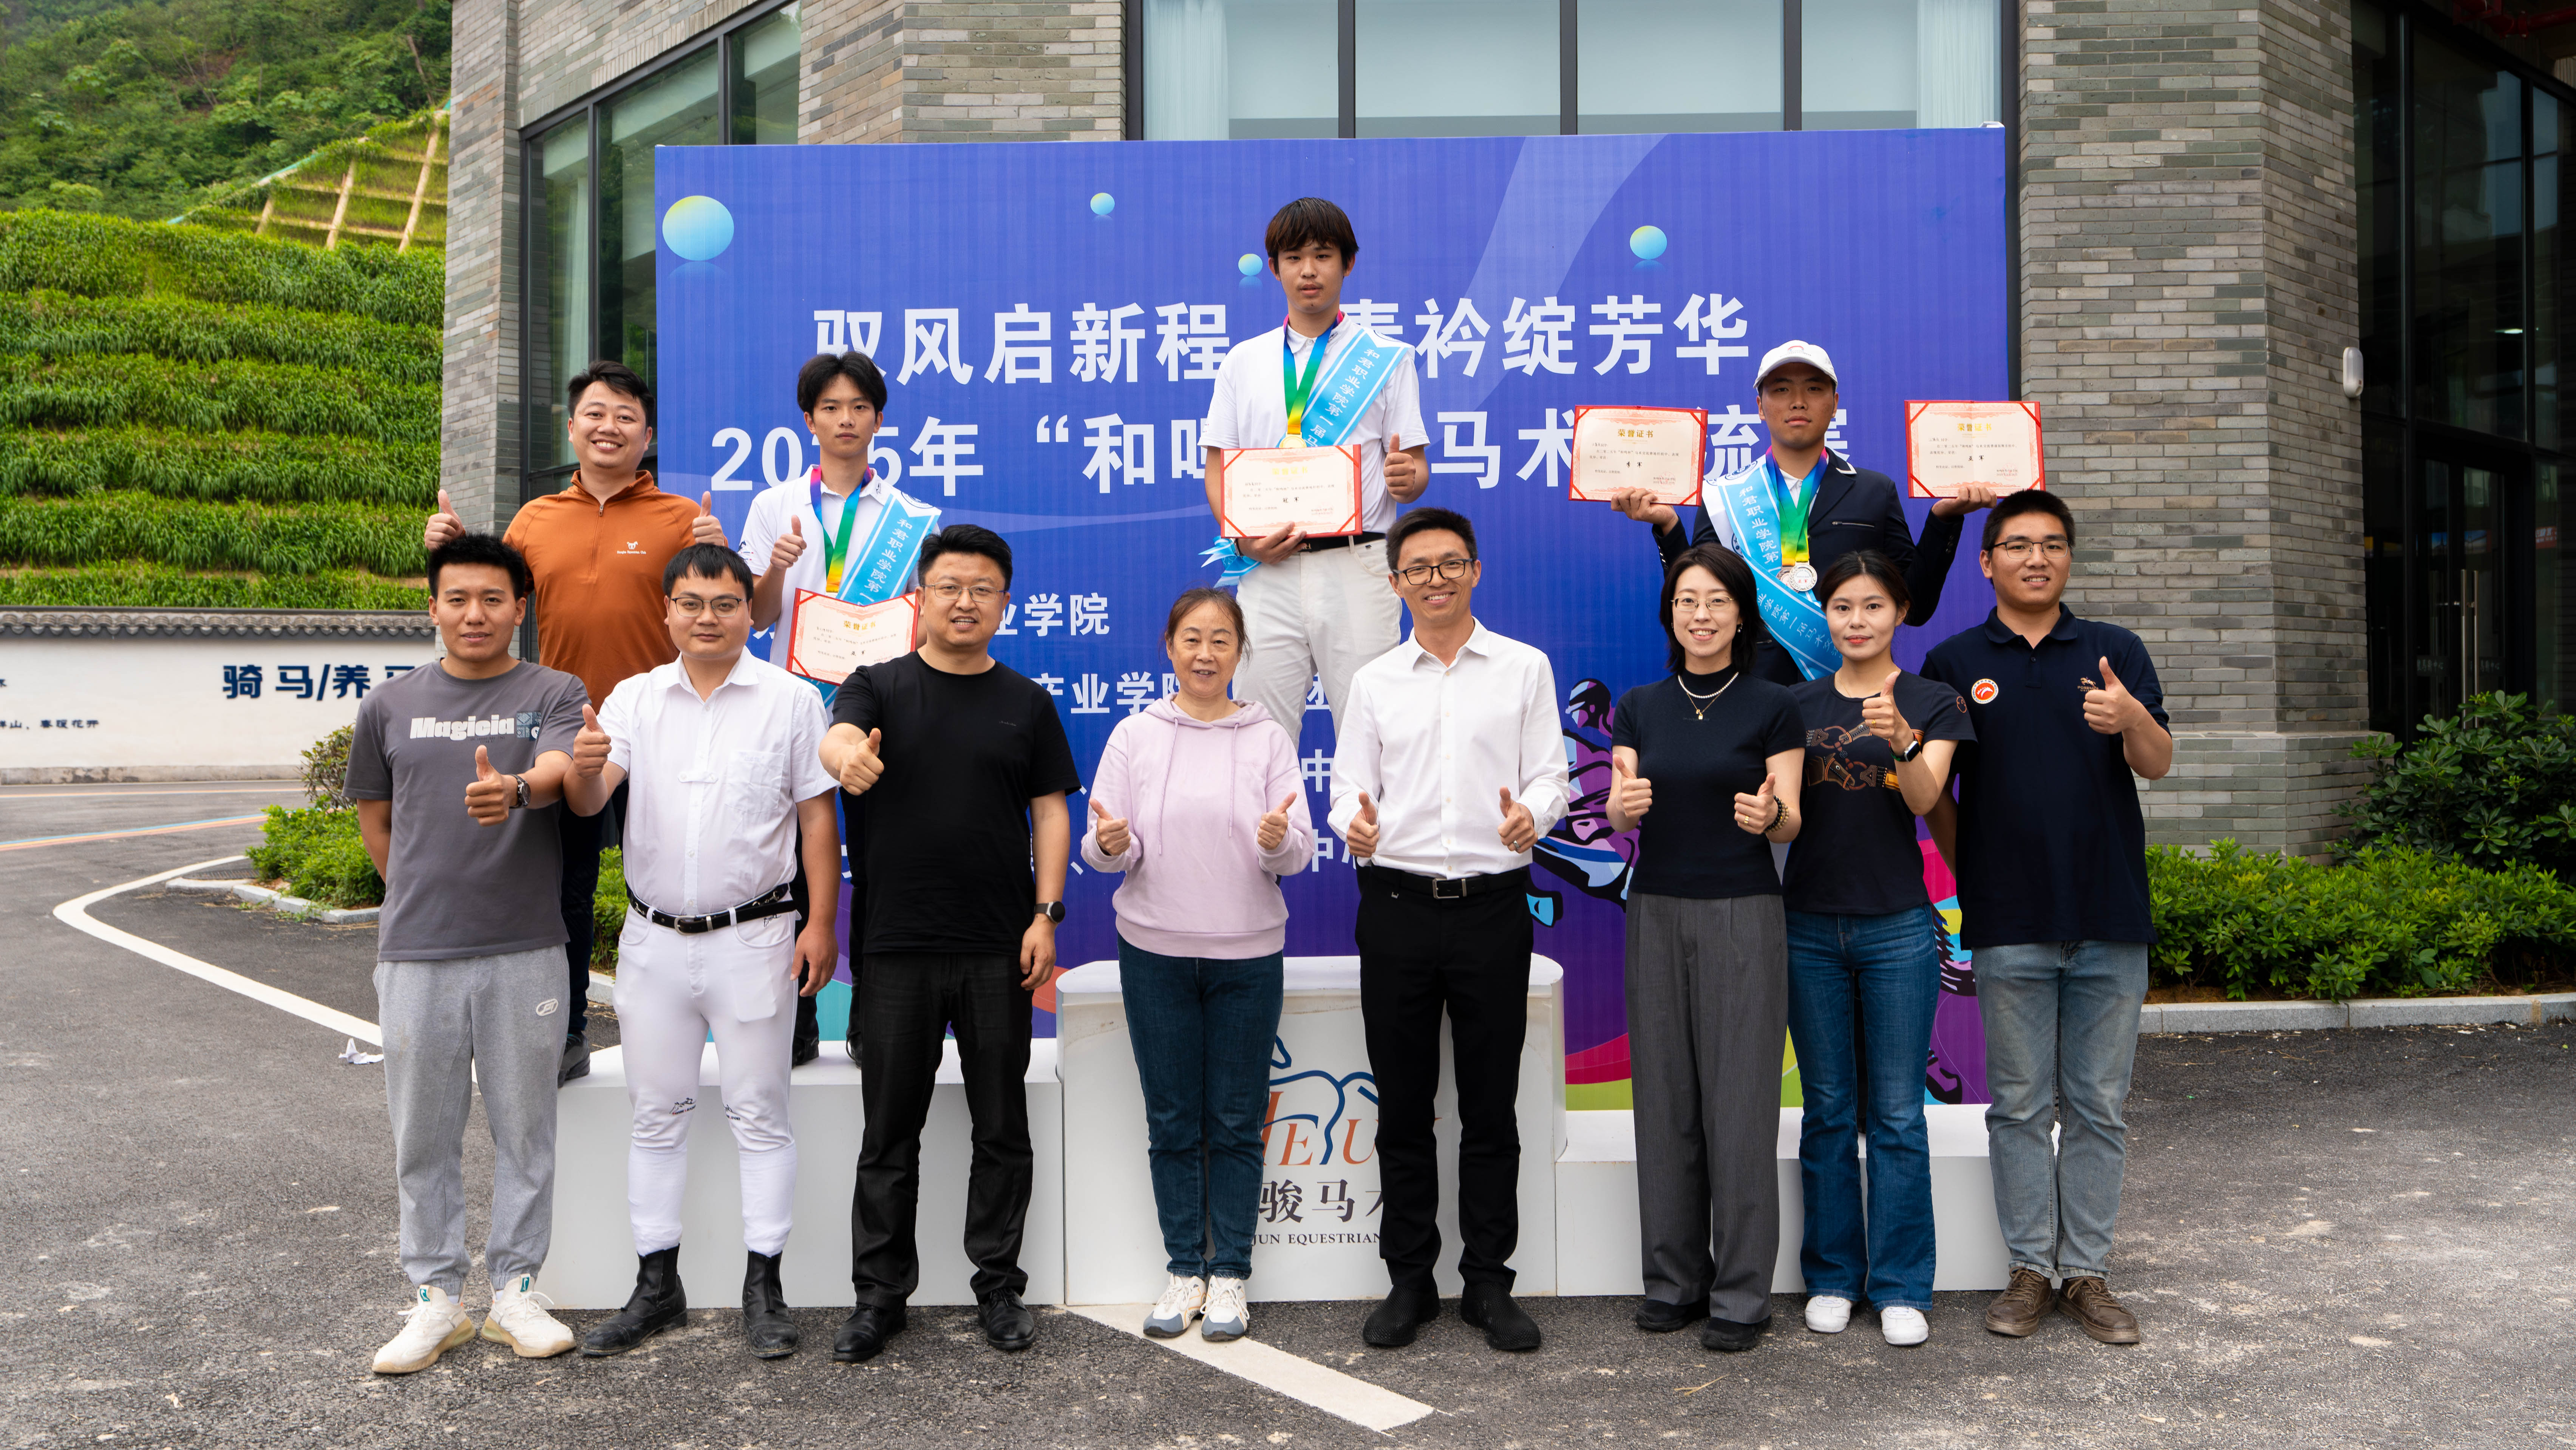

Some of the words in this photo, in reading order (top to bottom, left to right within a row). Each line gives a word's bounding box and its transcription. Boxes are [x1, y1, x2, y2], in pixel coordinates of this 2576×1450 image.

[814, 303, 1230, 385] 驭风启新程
[1618, 429, 1653, 438] 荣誉证书
[1738, 486, 1781, 573] 和君职业学院第一
[858, 518, 913, 606] 和君职业学院第一
[843, 620, 876, 631] 荣誉证书
[1288, 1233, 1380, 1246] EQUESTRIAN
